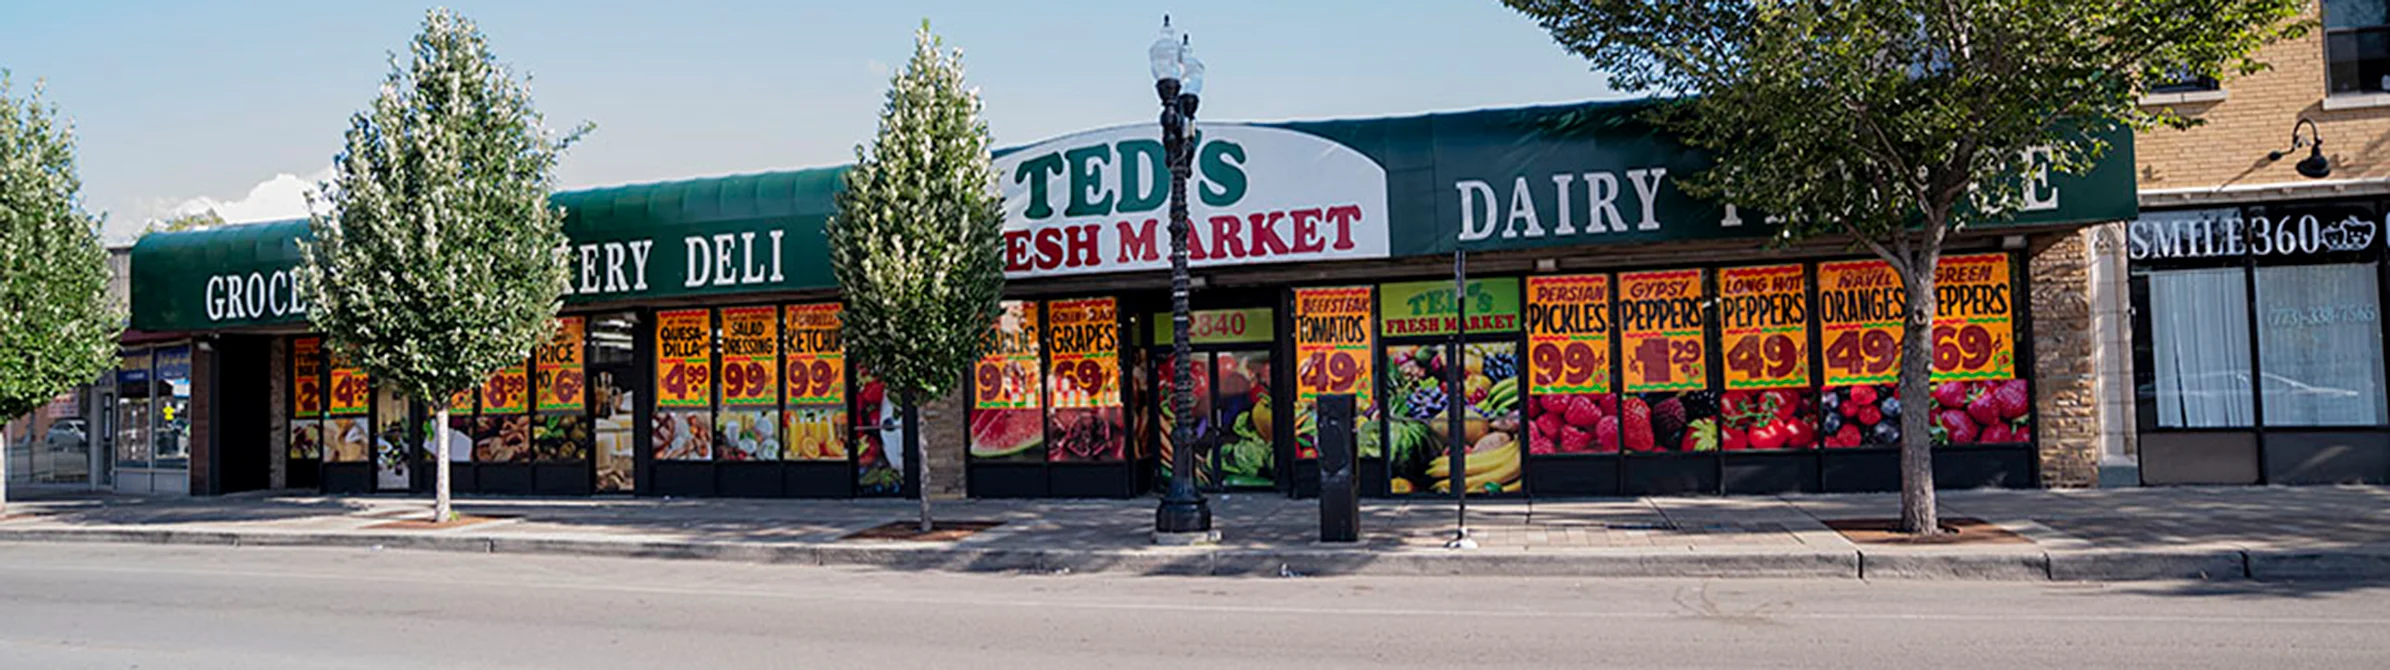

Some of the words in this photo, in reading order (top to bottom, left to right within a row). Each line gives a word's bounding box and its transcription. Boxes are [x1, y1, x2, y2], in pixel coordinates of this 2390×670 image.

[1455, 168, 1666, 241] DAIRY
[684, 229, 784, 288] DELI
[1003, 224, 1101, 272] ESH
[1536, 284, 1606, 302] PERSIAN
[1629, 280, 1690, 298] GYPSY
[1725, 276, 1768, 294] LONG
[1772, 273, 1804, 292] HOT
[1838, 270, 1893, 289] NAVEL
[1303, 296, 1369, 314] BEEFSTEAK
[1621, 296, 1703, 331] PEPPERS
[1723, 291, 1805, 328] PEPPERS
[1821, 286, 1906, 323] ORANGES
[1937, 282, 2008, 317] EPPERS
[731, 320, 766, 337] SALAD
[1297, 315, 1366, 343] TOMATOS
[1386, 317, 1440, 333] FRESH
[1528, 302, 1607, 335] PICKLES
[540, 342, 575, 363] RICE
[1051, 323, 1116, 354] GRAPES
